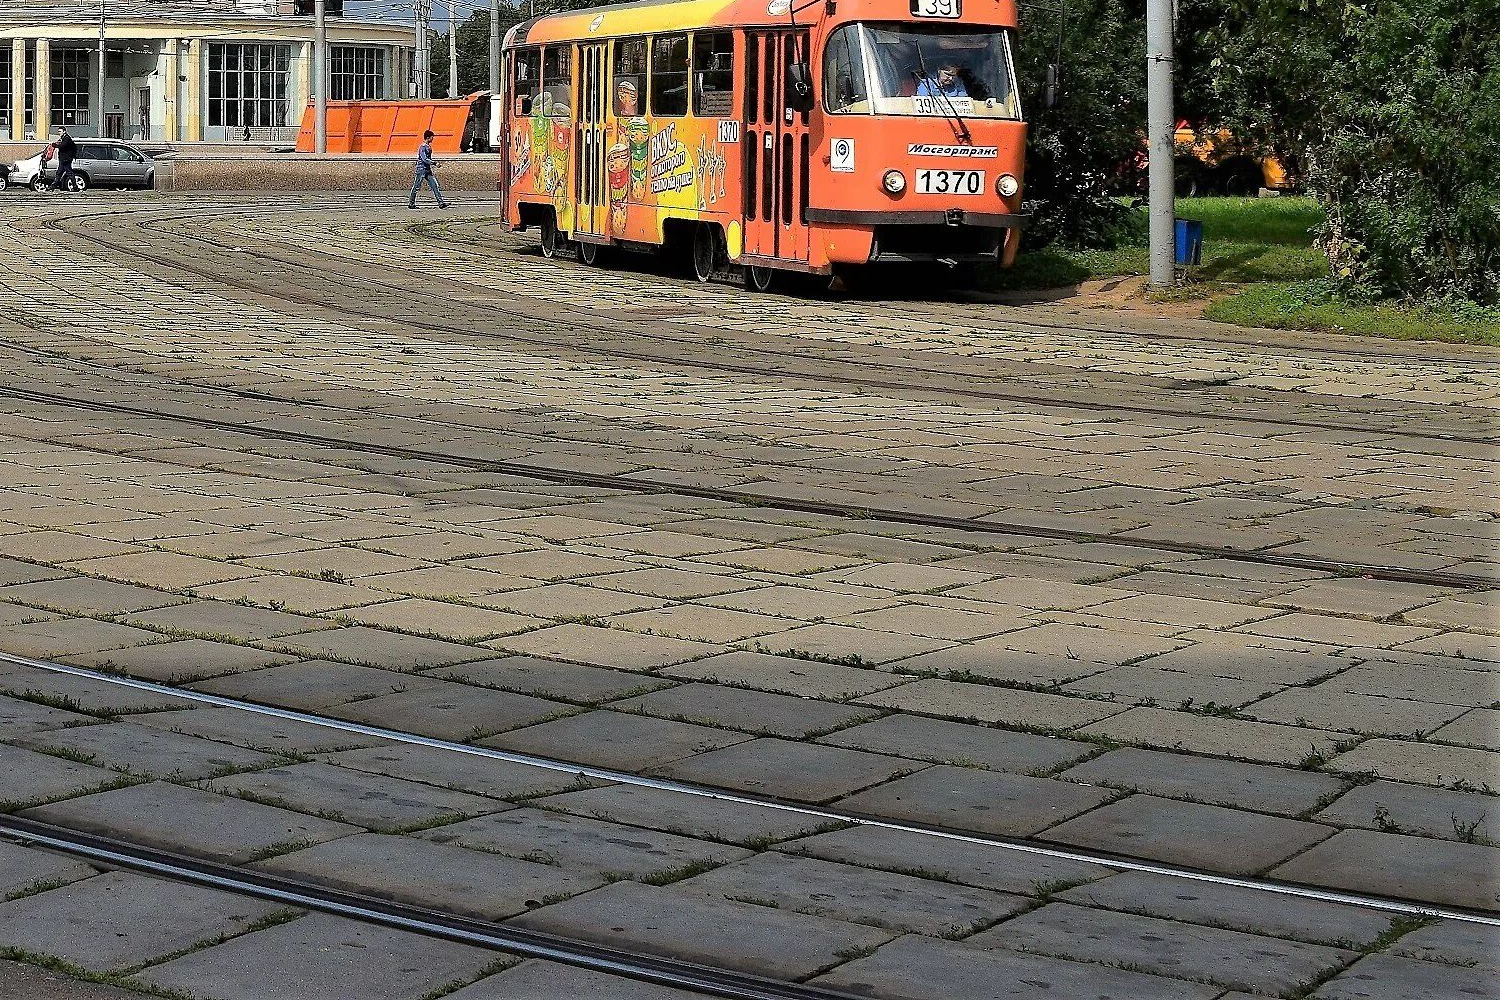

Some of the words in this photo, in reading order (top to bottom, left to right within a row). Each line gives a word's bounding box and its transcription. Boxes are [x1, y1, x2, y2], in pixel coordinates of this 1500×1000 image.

[916, 98, 932, 114] 39
[719, 121, 739, 142] 1370
[908, 144, 998, 158] Мосгортранс
[920, 170, 980, 194] 1370
